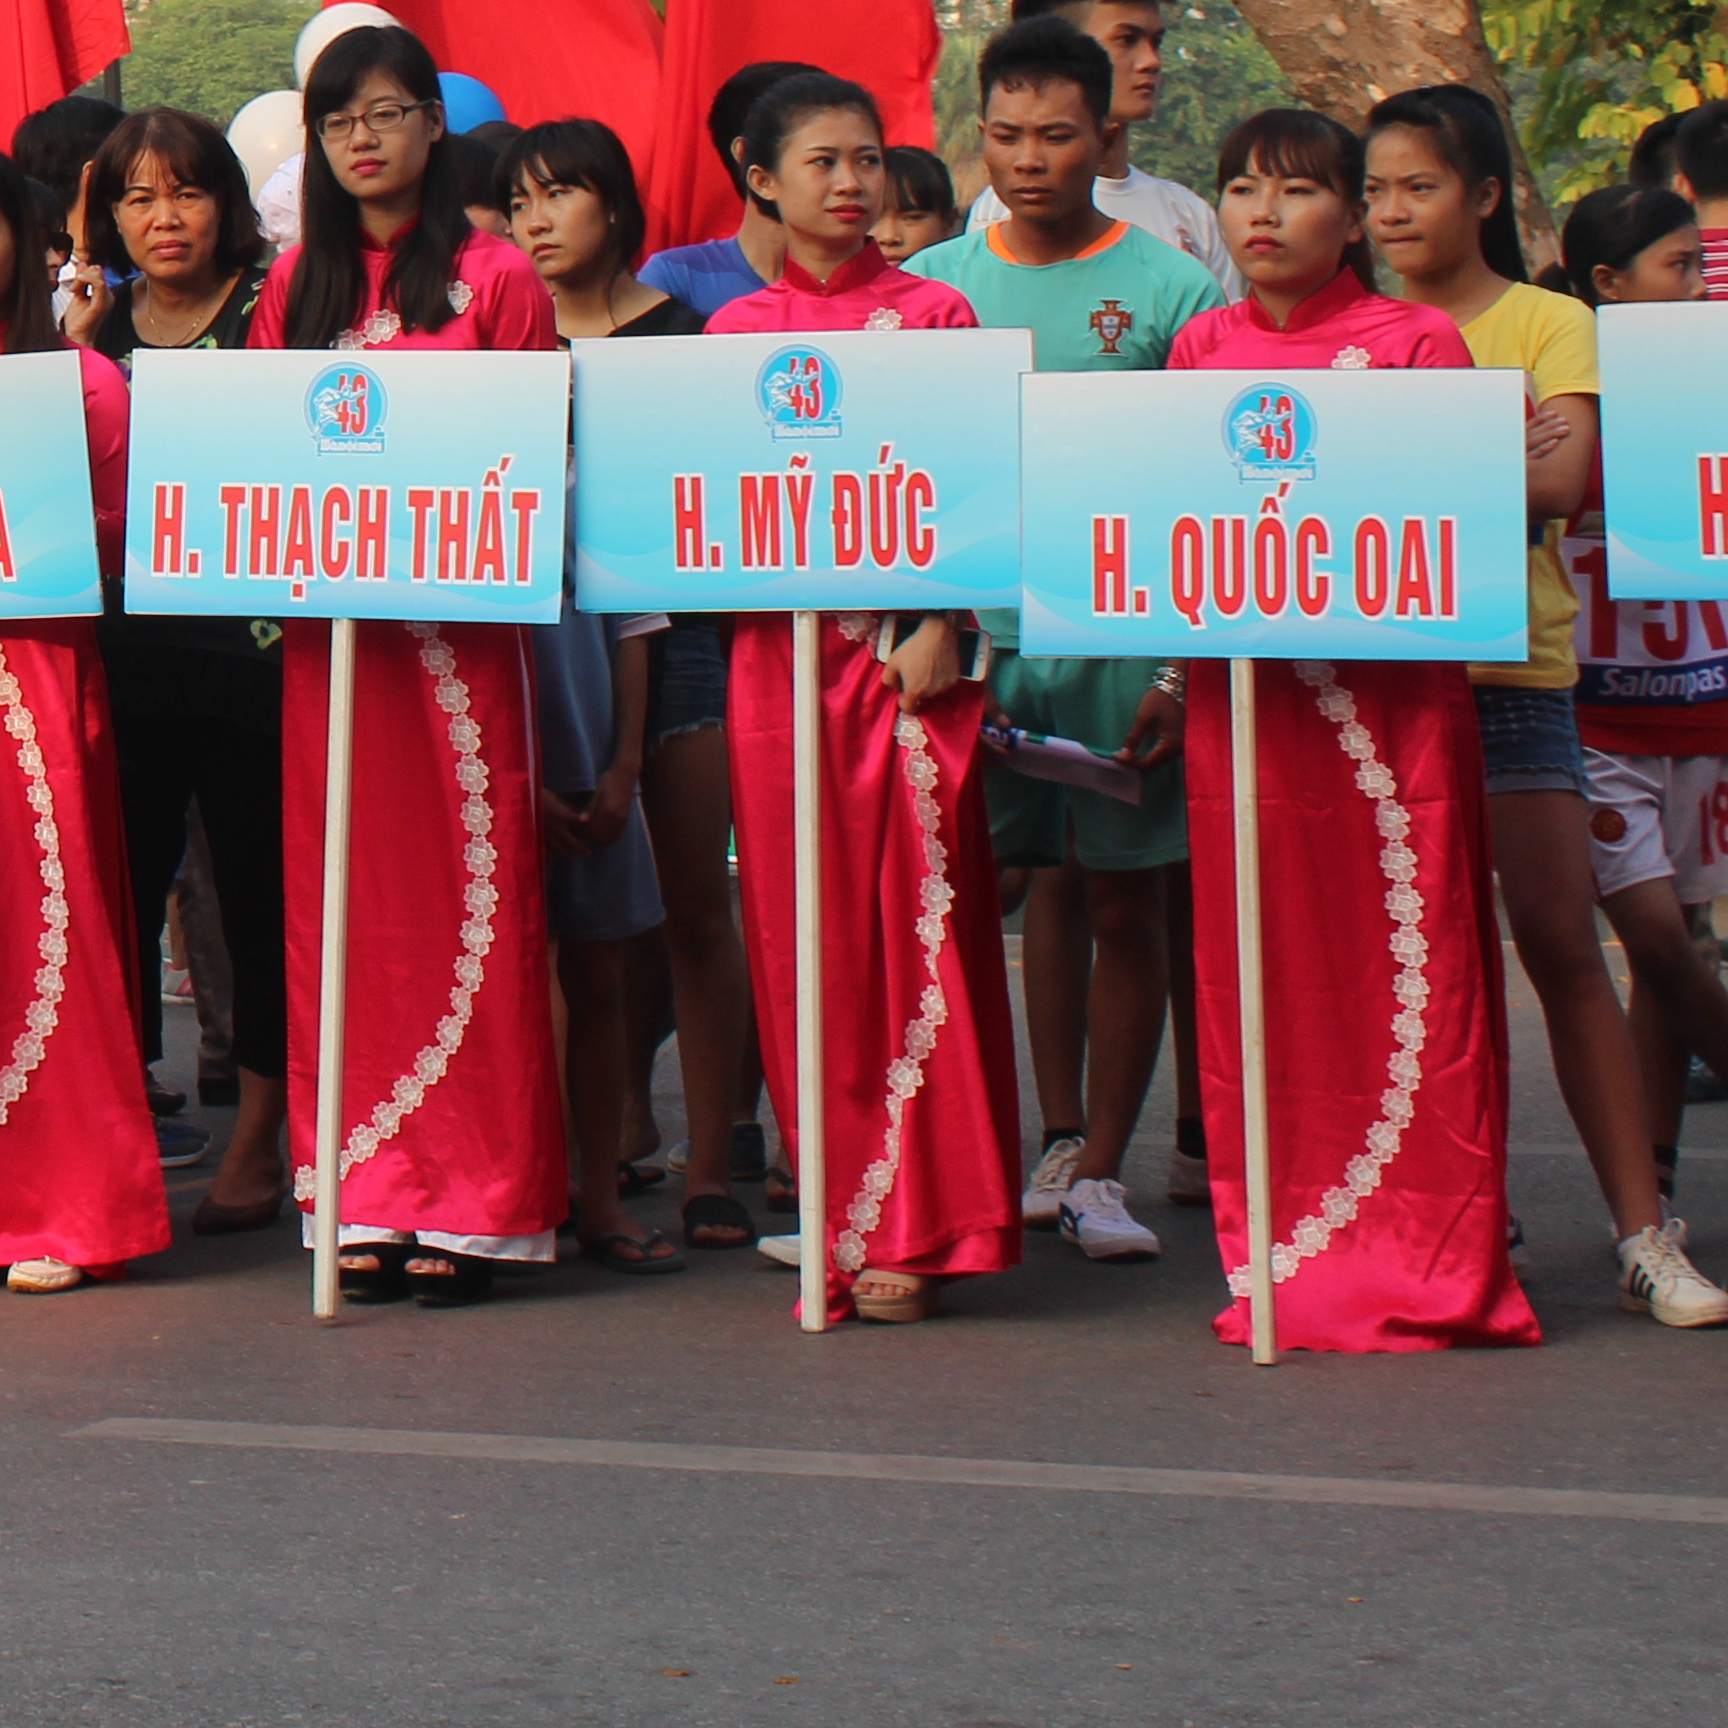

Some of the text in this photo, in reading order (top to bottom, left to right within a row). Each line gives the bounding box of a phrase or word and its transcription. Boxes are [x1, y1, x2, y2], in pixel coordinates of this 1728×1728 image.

[151, 455, 541, 600] H. THẠCH THẤT
[673, 443, 937, 570] H. MỸ ĐỨC
[1092, 480, 1456, 628] H. QUỐC OAI
[1599, 665, 1727, 702] Salonpas
